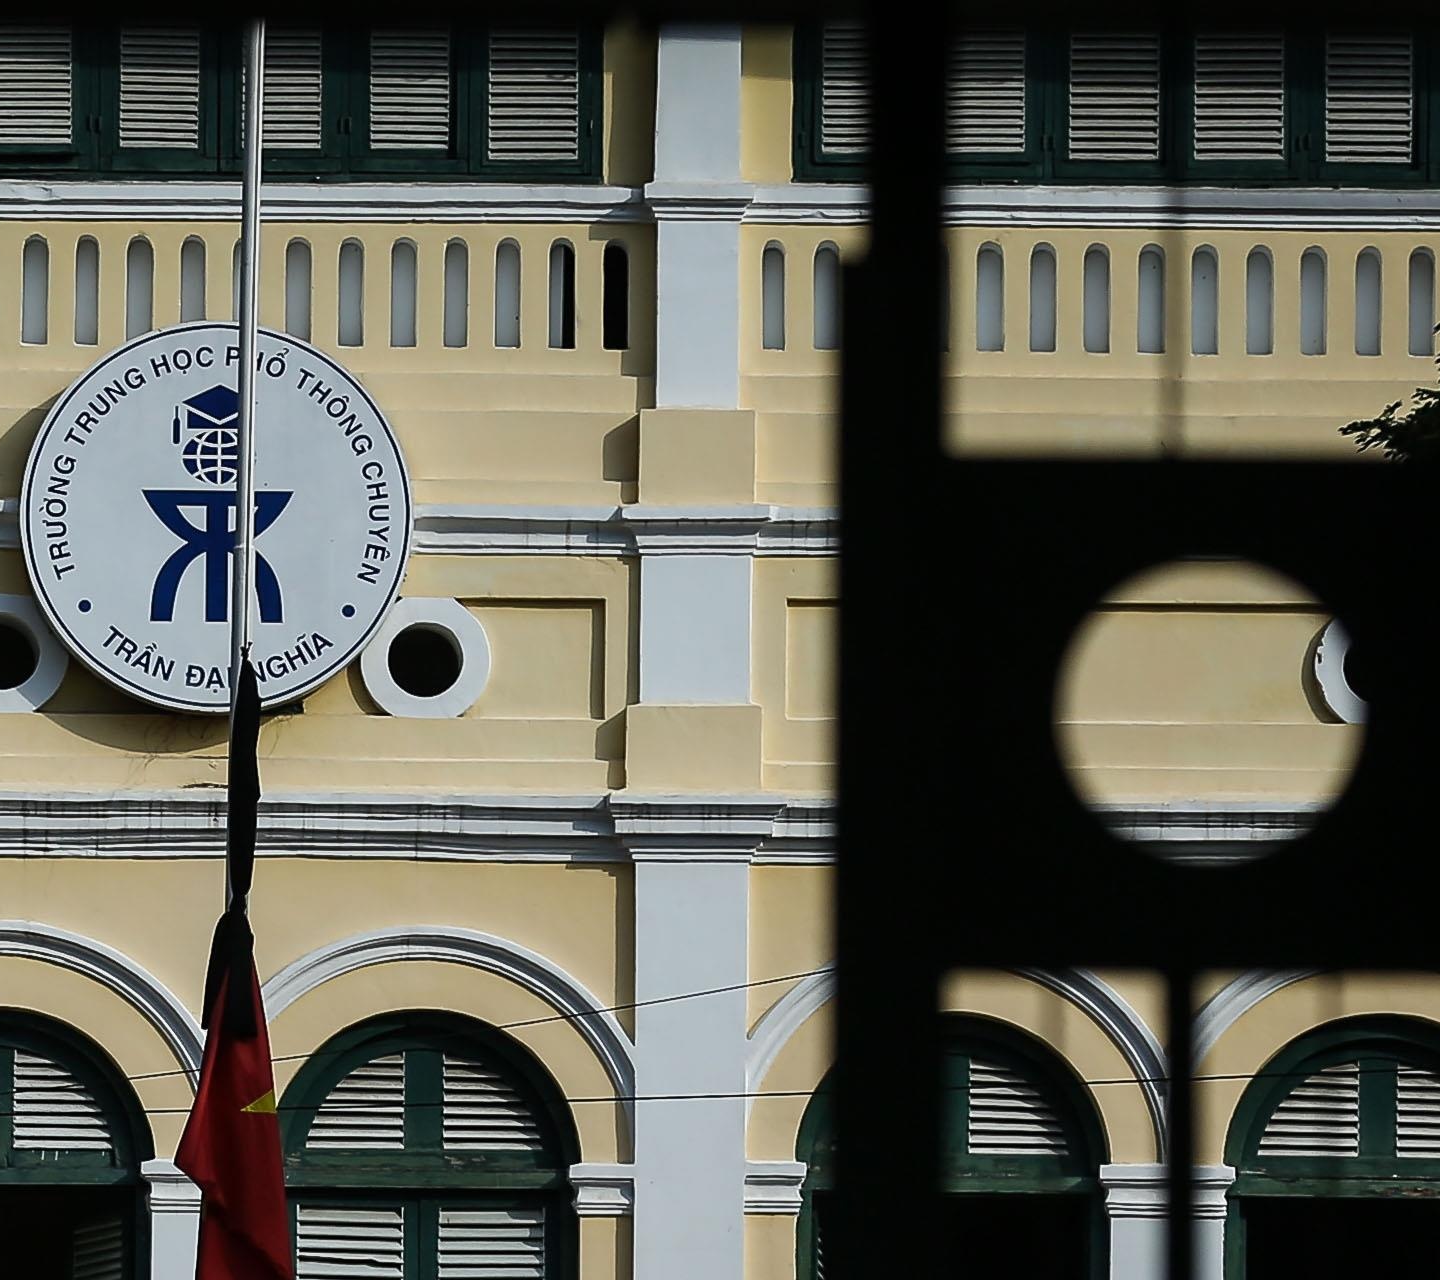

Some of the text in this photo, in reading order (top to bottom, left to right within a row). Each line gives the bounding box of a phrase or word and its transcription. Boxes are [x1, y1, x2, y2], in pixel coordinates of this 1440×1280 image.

[39, 454, 77, 580] TRƯỜNG
[65, 367, 147, 446] TRUNG
[150, 346, 215, 378] HỌC
[296, 367, 373, 457] THÔNG
[357, 461, 391, 584] CHUYÊN
[101, 625, 175, 681] TRẦN
